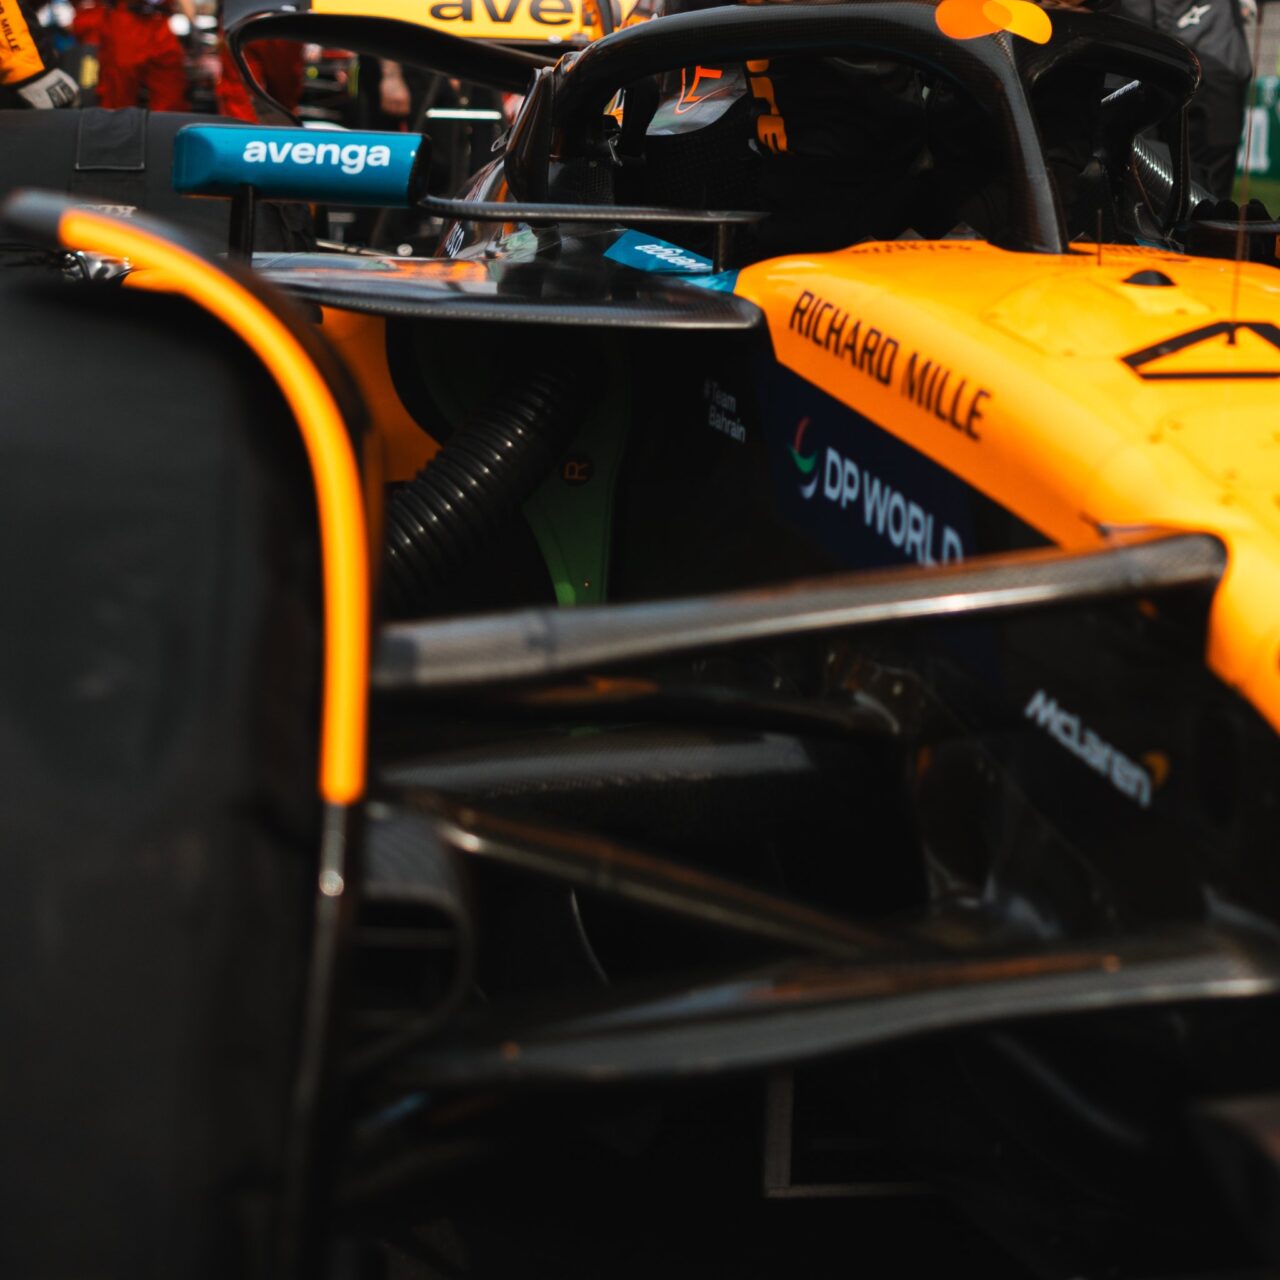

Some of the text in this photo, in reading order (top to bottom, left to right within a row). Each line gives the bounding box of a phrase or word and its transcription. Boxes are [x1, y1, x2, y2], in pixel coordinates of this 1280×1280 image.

[243, 140, 391, 175] avenga
[789, 290, 991, 442] RICHARD MILLE
[824, 446, 861, 509] DP
